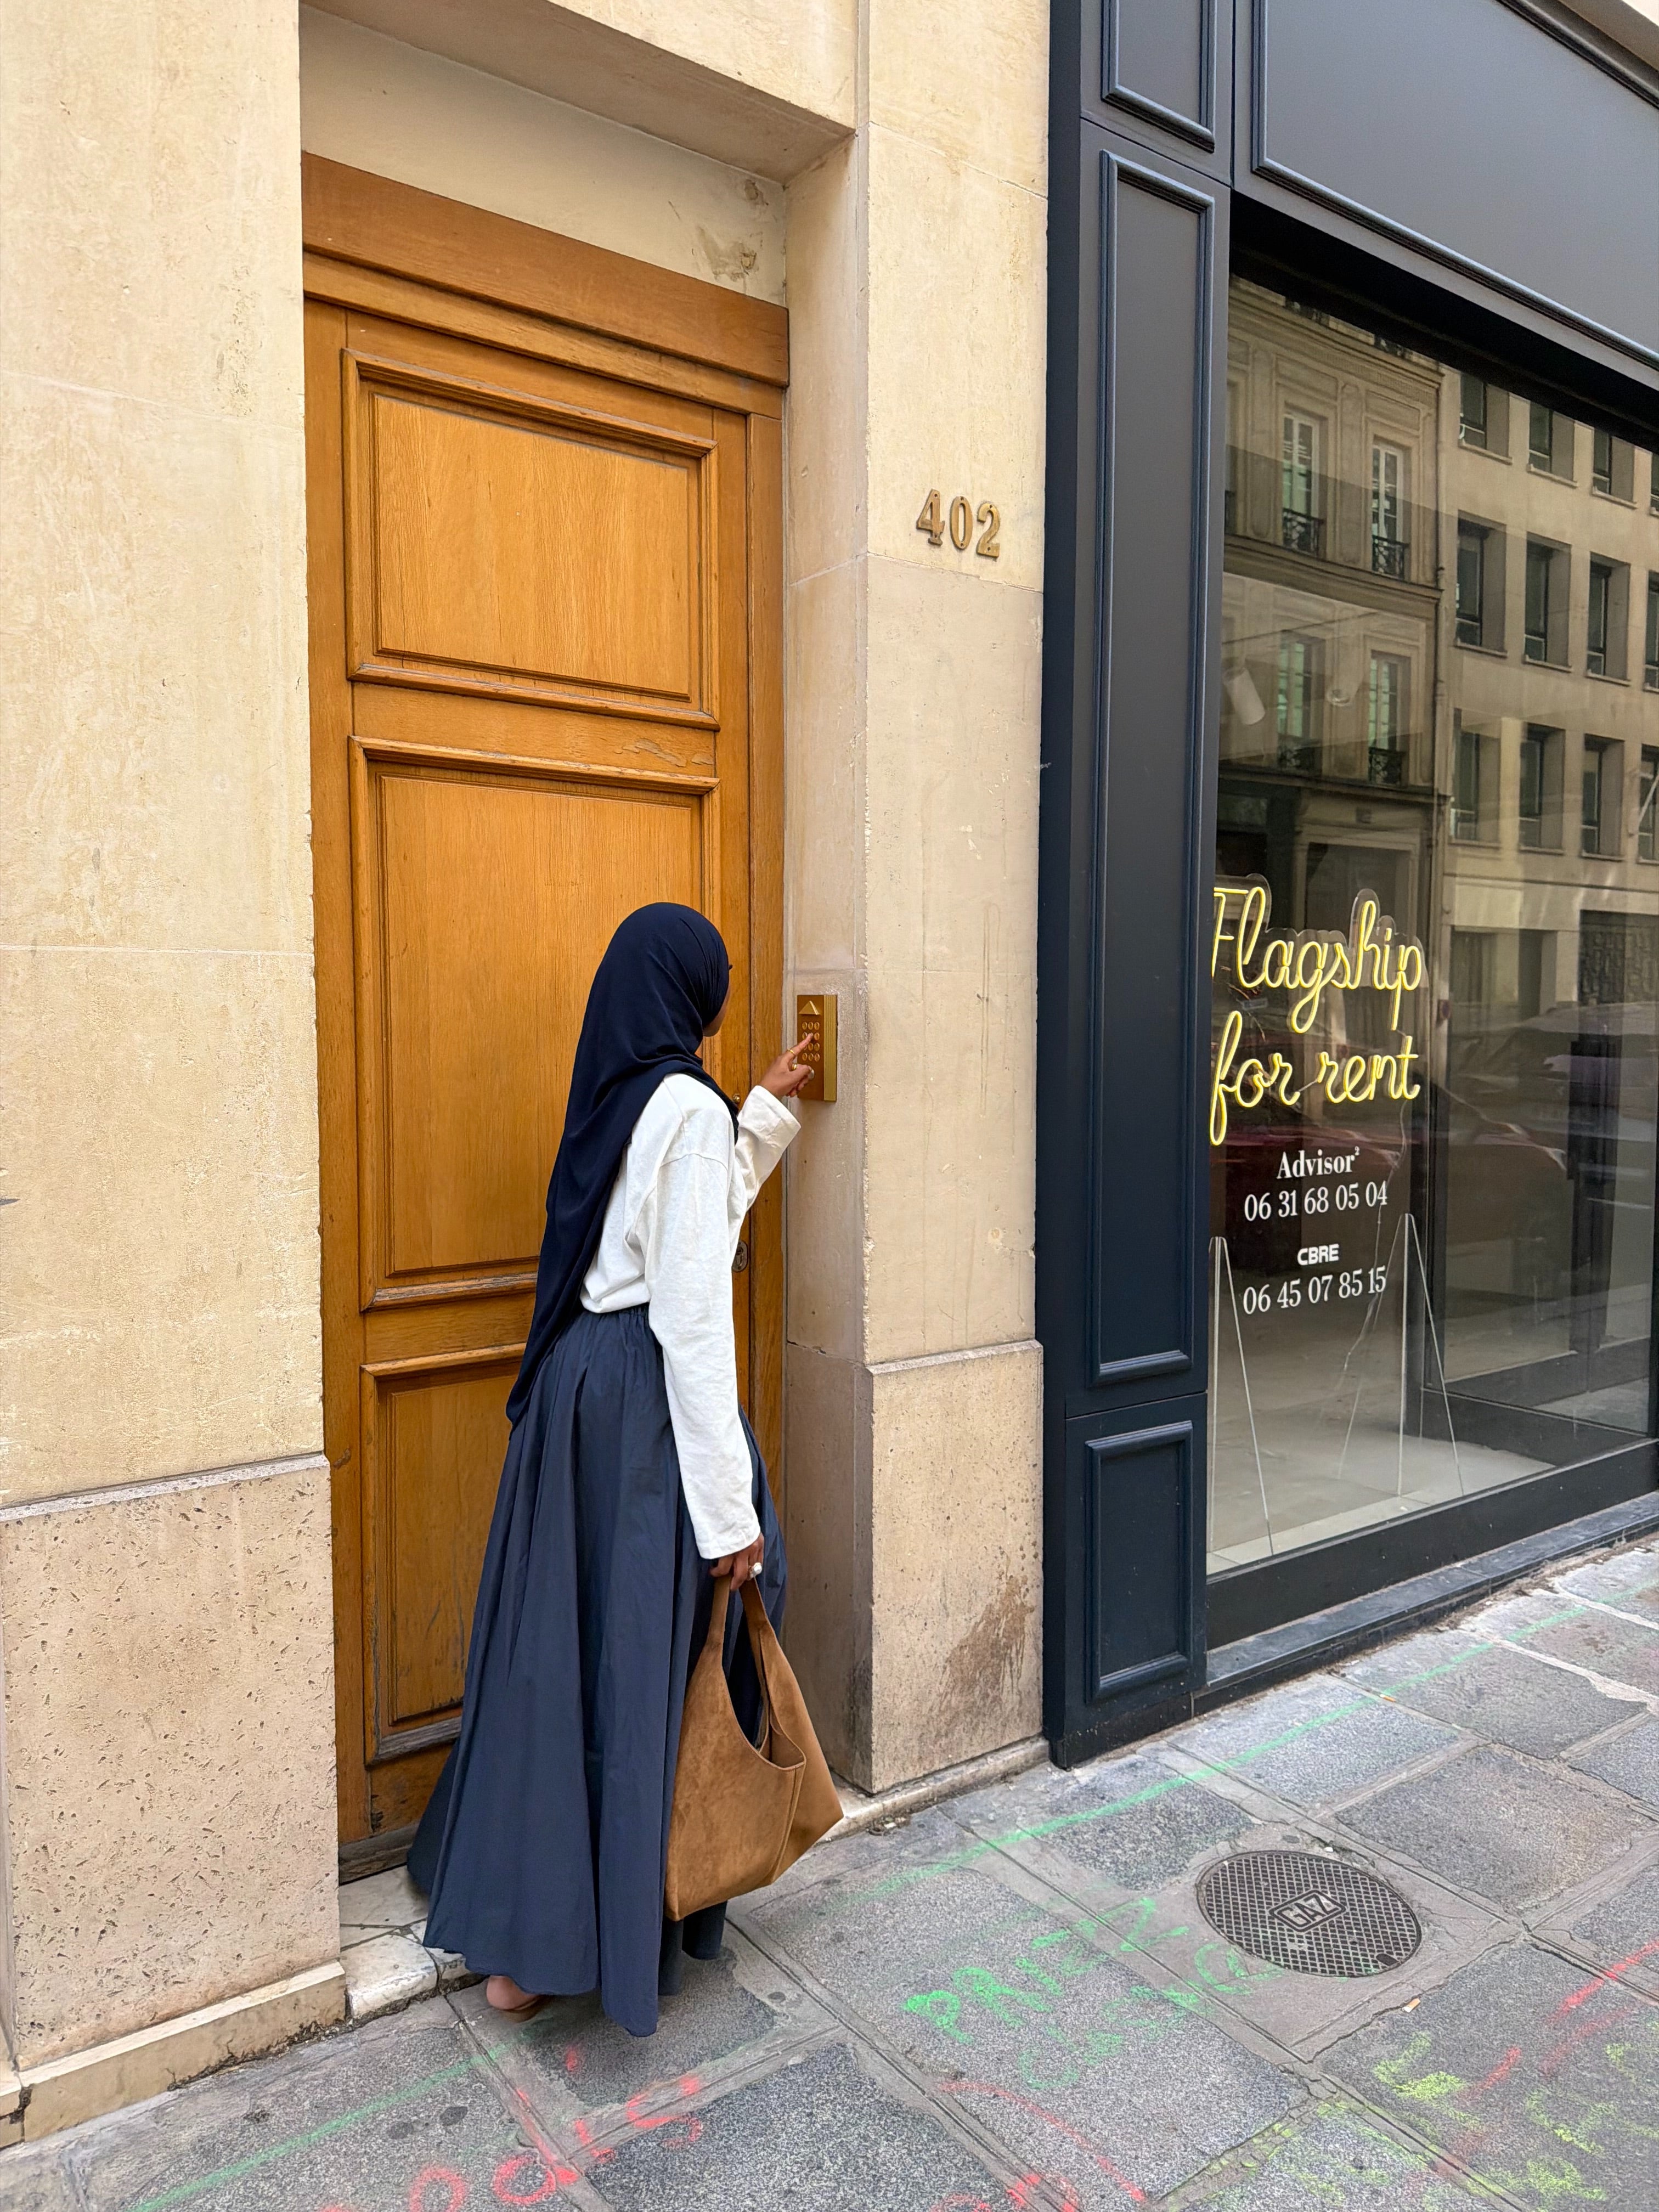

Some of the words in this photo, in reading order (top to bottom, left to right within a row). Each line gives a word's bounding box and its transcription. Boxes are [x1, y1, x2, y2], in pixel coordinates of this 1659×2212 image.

[916, 489, 1000, 558] 402
[1211, 887, 1421, 1034] Flagship
[1209, 1011, 1301, 1146] for
[1317, 1035, 1421, 1103] rent
[1244, 1192, 1272, 1221] 06
[1278, 1189, 1298, 1217] 31
[1304, 1187, 1329, 1215] 68
[1335, 1182, 1359, 1211] 05
[1365, 1181, 1387, 1207] 04
[1297, 1244, 1339, 1266] CBRE
[1243, 1284, 1271, 1314] 06
[1277, 1278, 1301, 1308] 45
[1308, 1274, 1333, 1304] 07
[1339, 1269, 1363, 1299] 85
[1368, 1265, 1386, 1294] 15
[1278, 1893, 1339, 1928] GAZ
